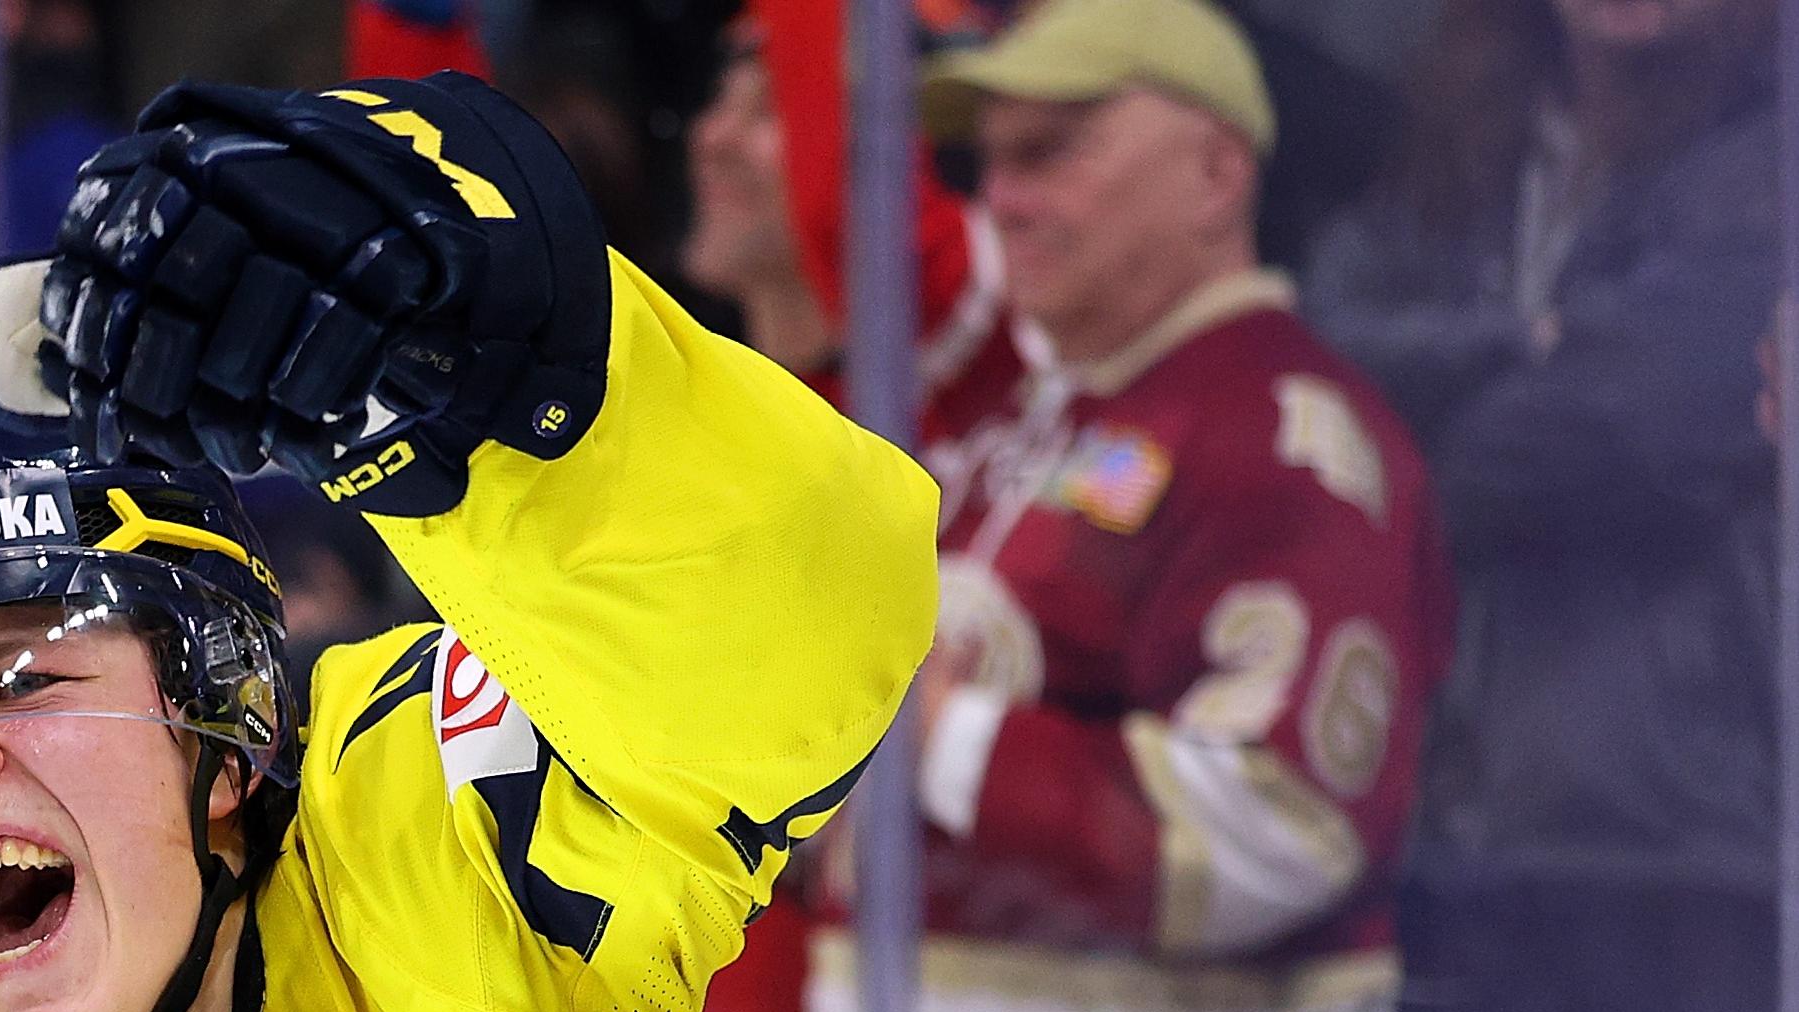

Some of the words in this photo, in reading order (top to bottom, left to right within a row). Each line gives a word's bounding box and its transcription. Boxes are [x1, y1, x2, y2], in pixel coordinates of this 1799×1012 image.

[540, 405, 566, 432] 15
[320, 440, 415, 503] CCM
[251, 555, 283, 600] CC
[244, 713, 271, 744] CCM
